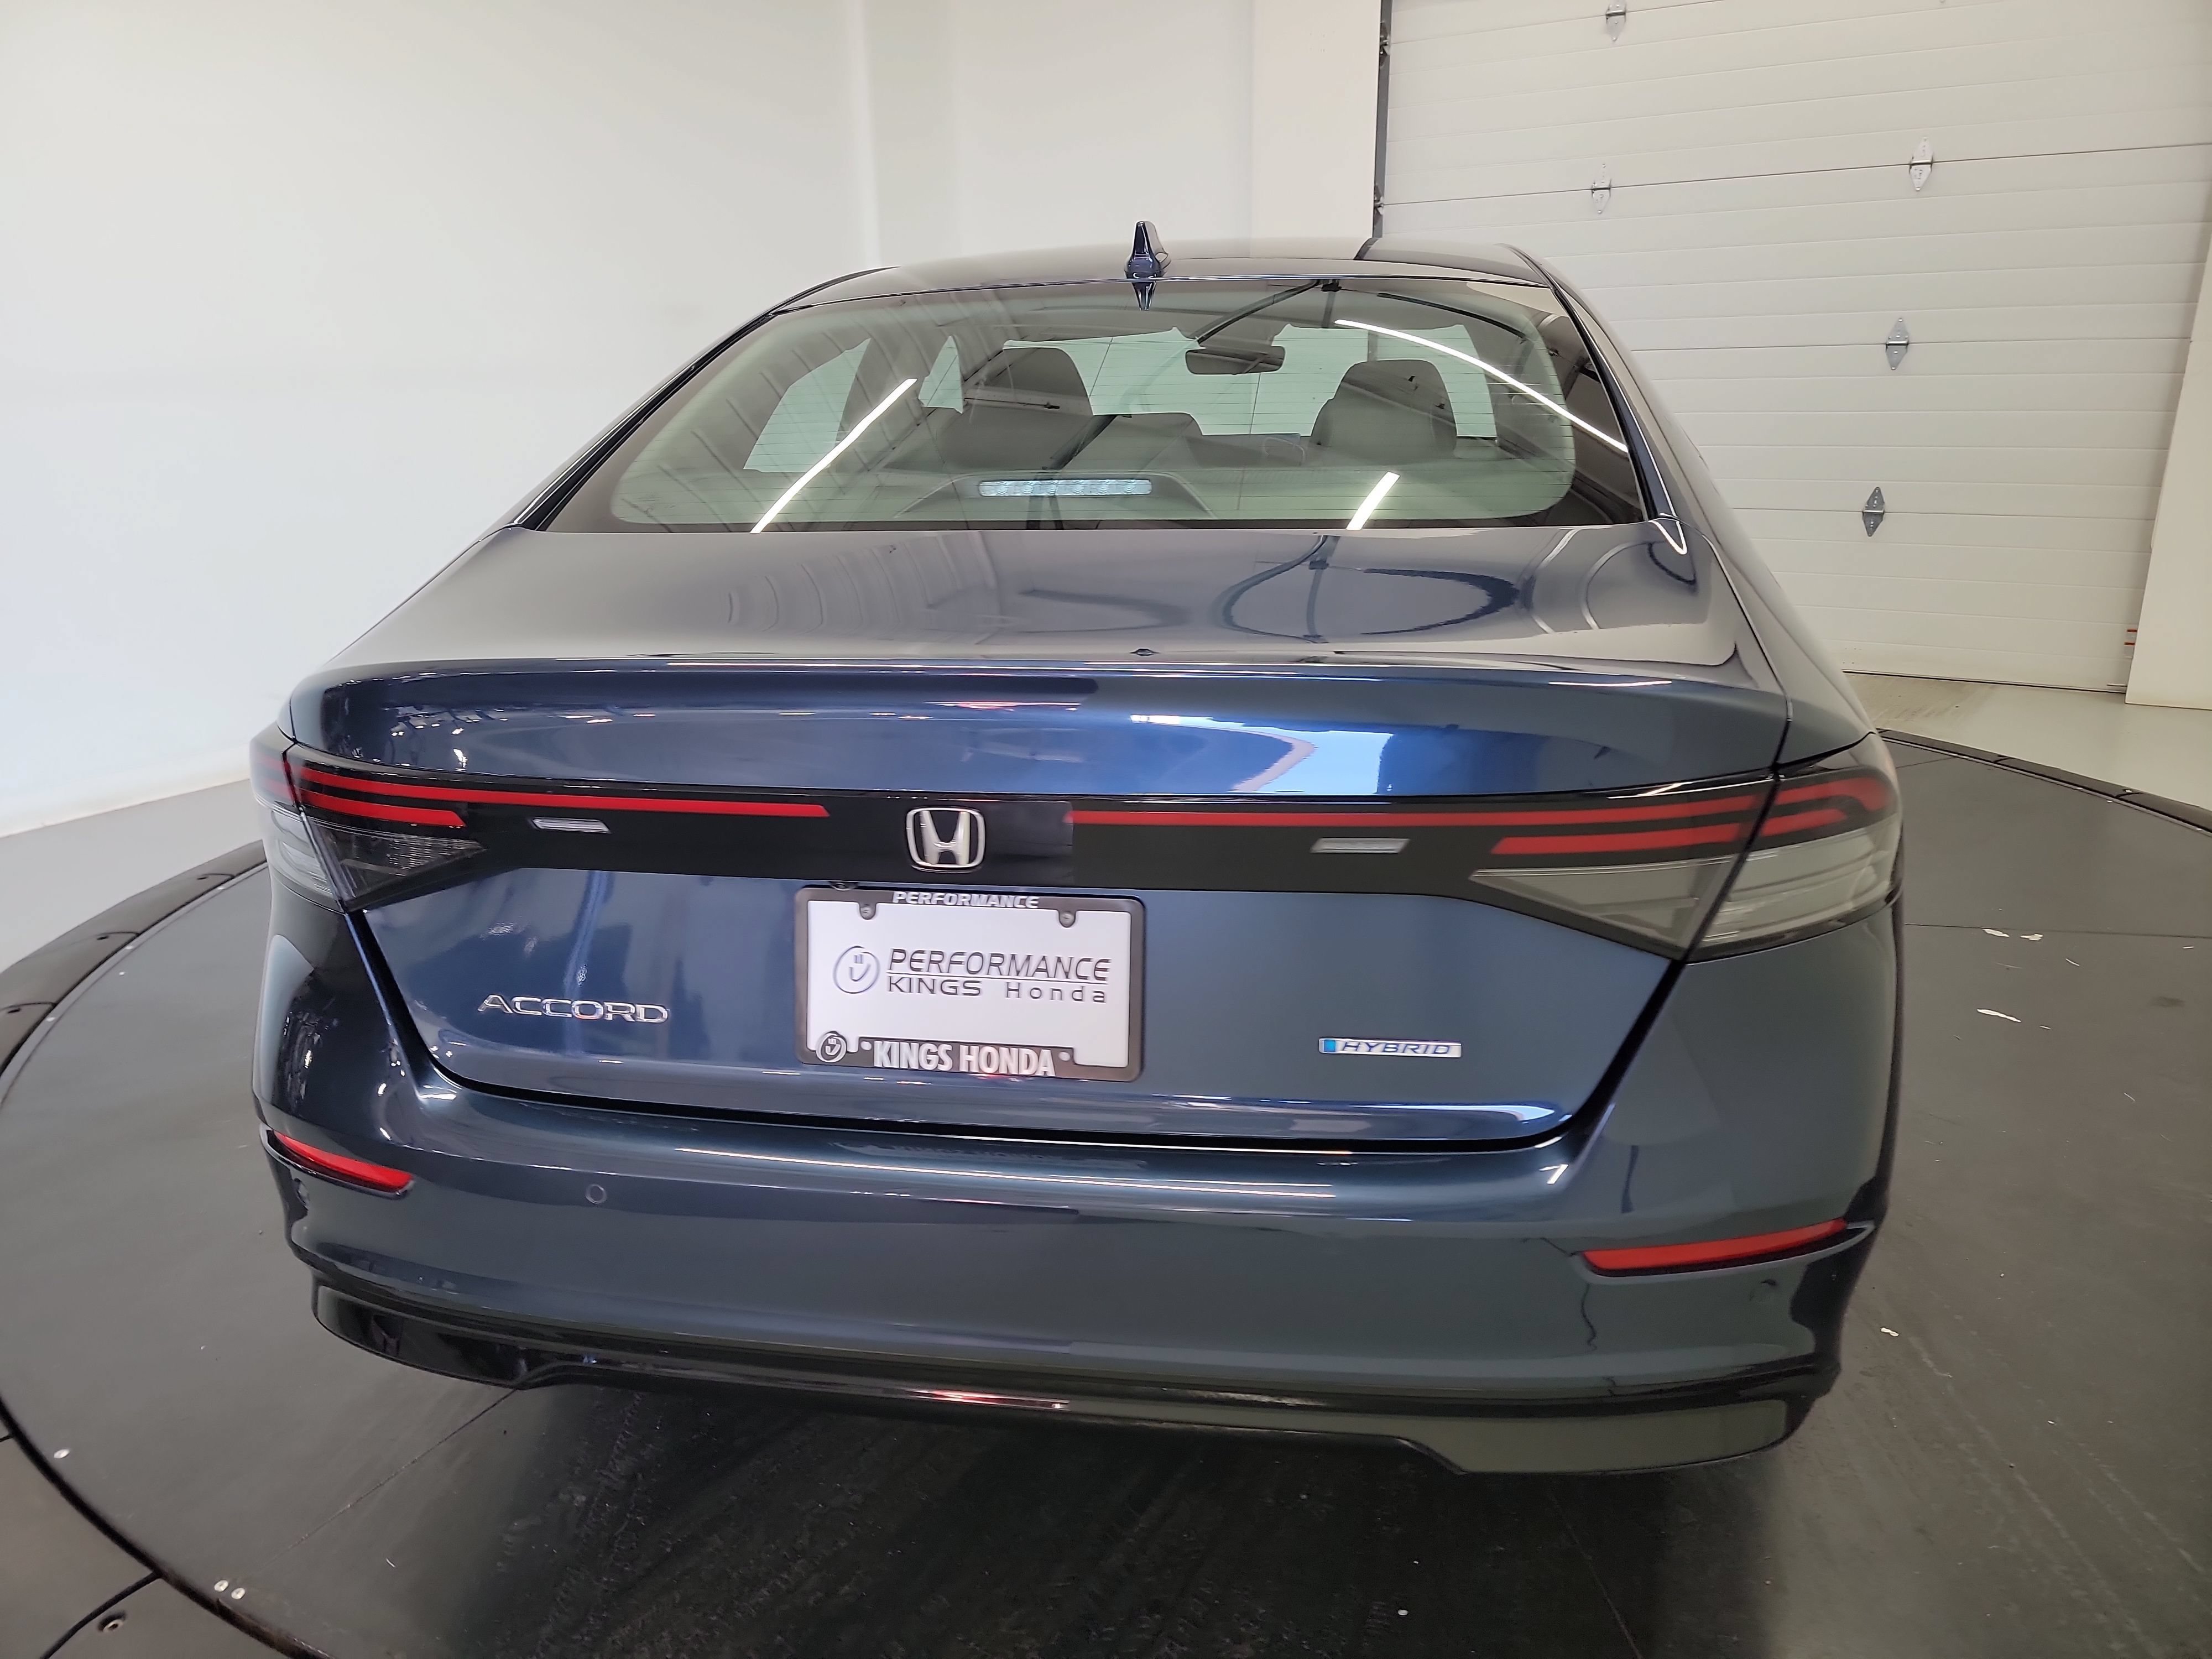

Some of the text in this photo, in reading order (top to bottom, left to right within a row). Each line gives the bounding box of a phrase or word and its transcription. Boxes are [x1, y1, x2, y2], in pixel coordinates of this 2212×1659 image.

[892, 891, 1040, 909] PERFORMANCE
[887, 947, 1112, 982] PERFORMANCE
[888, 975, 1107, 1004] KINGS Honda
[477, 994, 669, 1023] ACCORD
[873, 1039, 1056, 1077] KINGS HONDA
[1342, 1041, 1451, 1055] HYBRID
